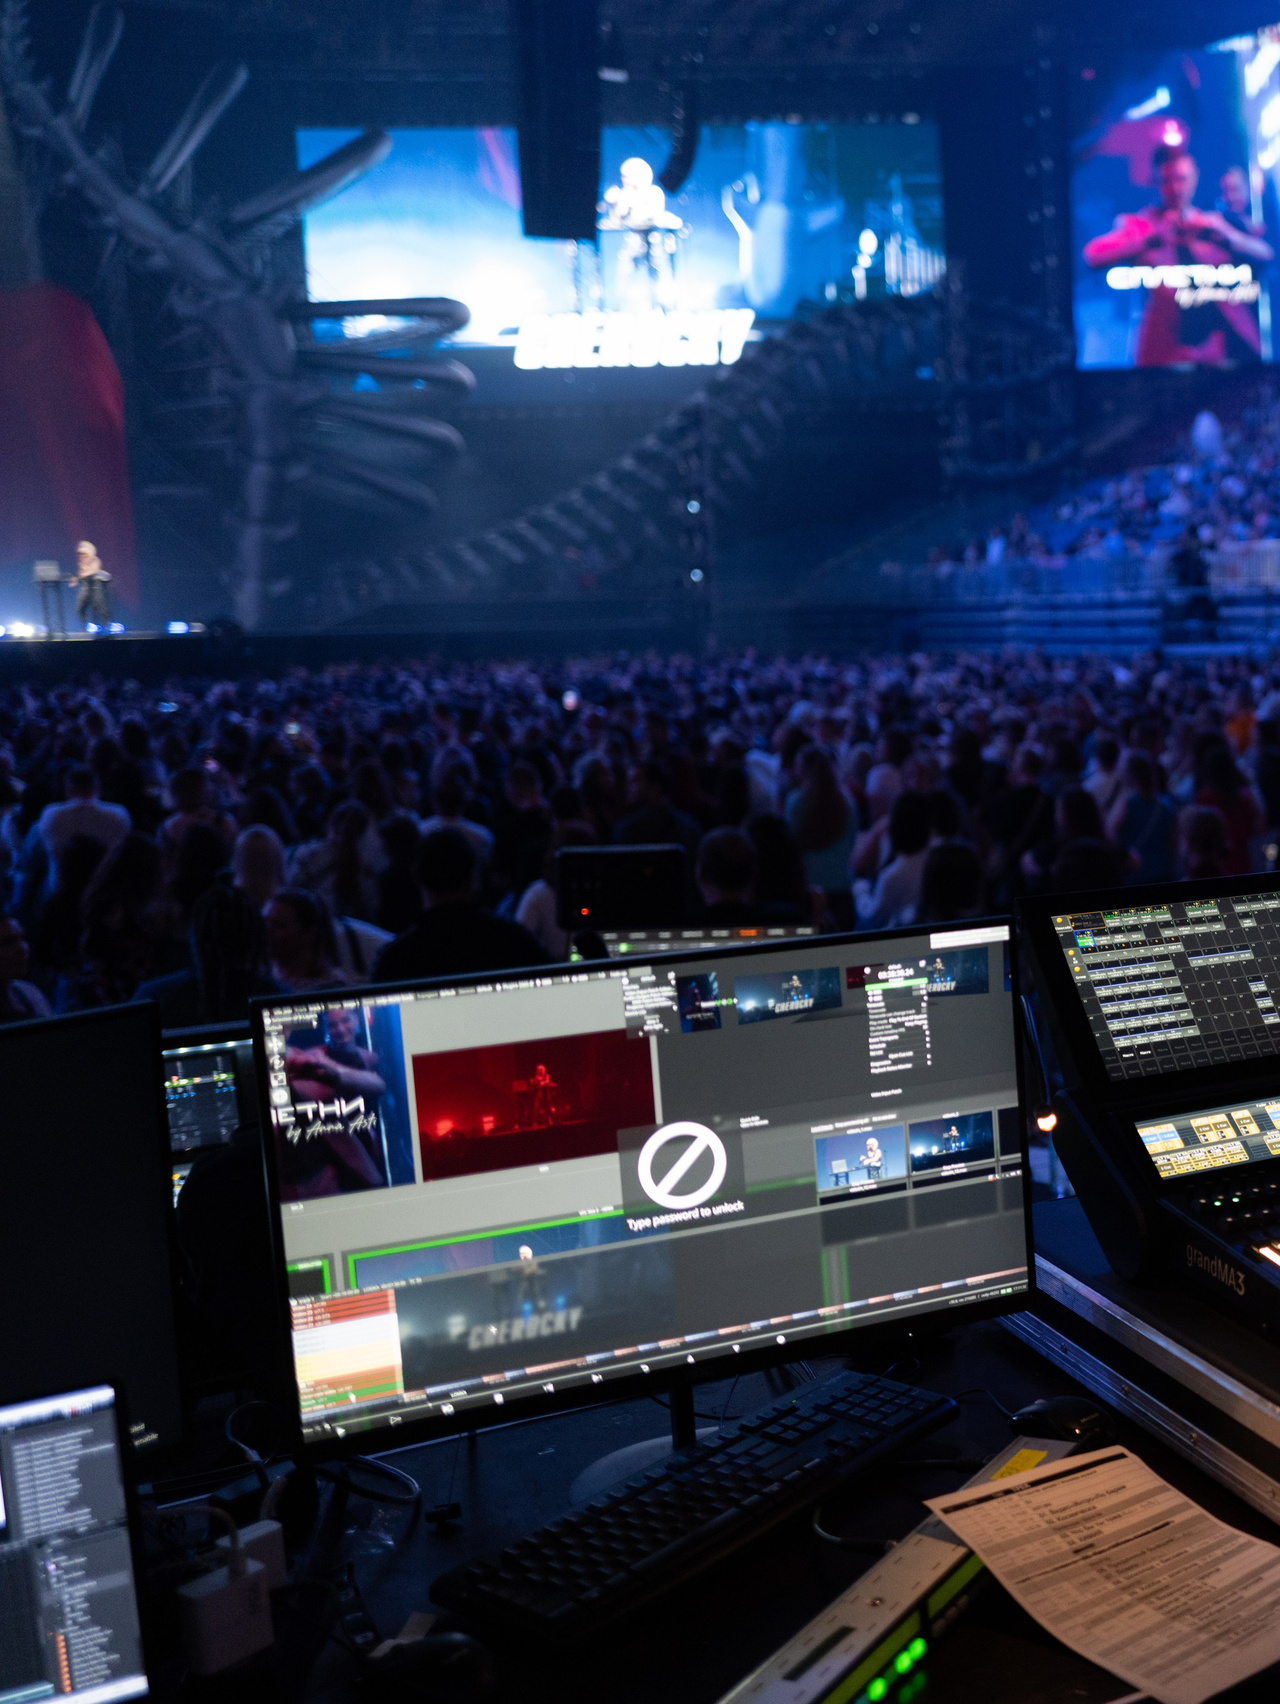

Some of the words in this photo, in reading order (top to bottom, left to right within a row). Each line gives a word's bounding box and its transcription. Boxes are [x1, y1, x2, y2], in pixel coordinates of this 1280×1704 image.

[626, 1217, 651, 1232] Type
[652, 1208, 700, 1228] password
[700, 1206, 711, 1218] to
[712, 1199, 744, 1216] unlock
[1187, 1244, 1245, 1296] grandMA3
